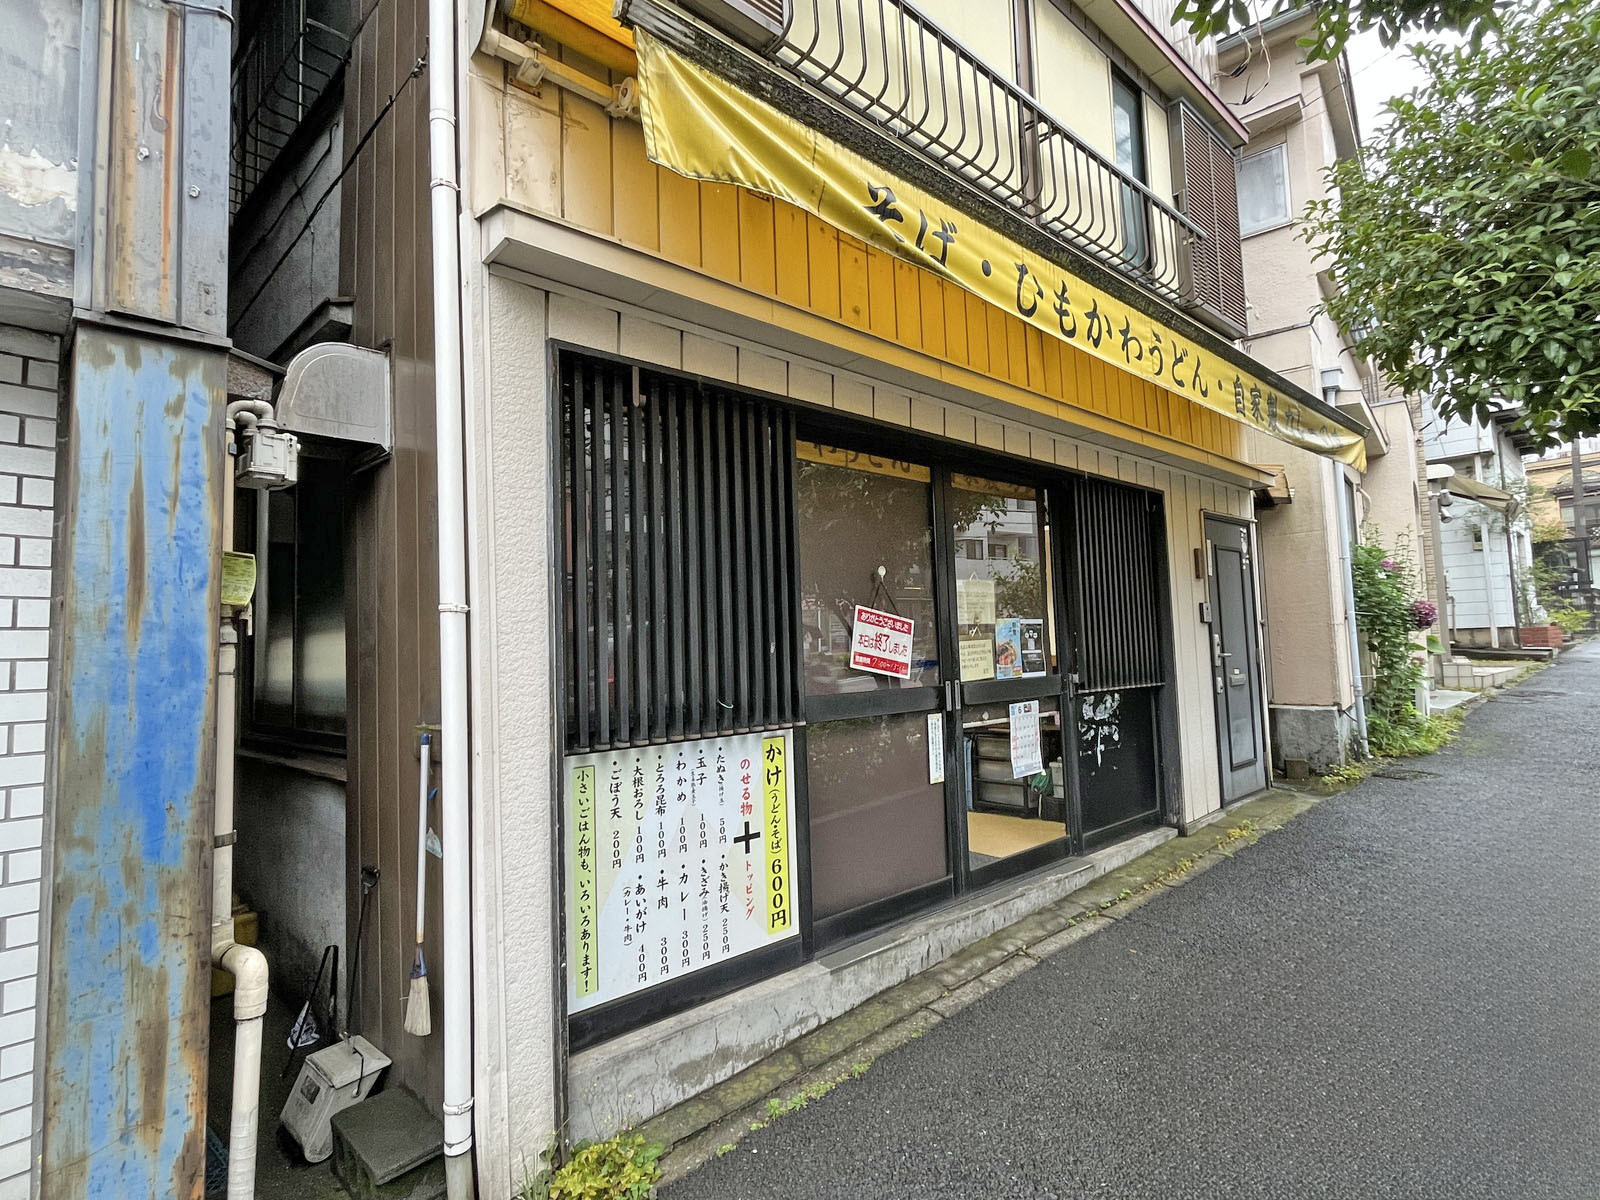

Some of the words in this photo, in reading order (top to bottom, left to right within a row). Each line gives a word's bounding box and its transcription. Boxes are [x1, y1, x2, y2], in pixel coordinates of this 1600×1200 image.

[858, 631, 908, 657] 本日は終了しました
[609, 767, 622, 819] ごぼう天
[632, 766, 644, 821] 大根おろし
[676, 760, 687, 802] わかめ
[740, 758, 753, 815] のせる物
[612, 830, 622, 869] 200円
[679, 817, 687, 853] 100円
[699, 813, 708, 848] 100円
[719, 818, 727, 844] 50円
[635, 882, 647, 934] あいがけ
[679, 873, 689, 921] カレー
[744, 860, 755, 920] トッピング
[638, 944, 647, 983] 400円
[660, 937, 669, 975] 300円
[681, 930, 690, 968] 300円
